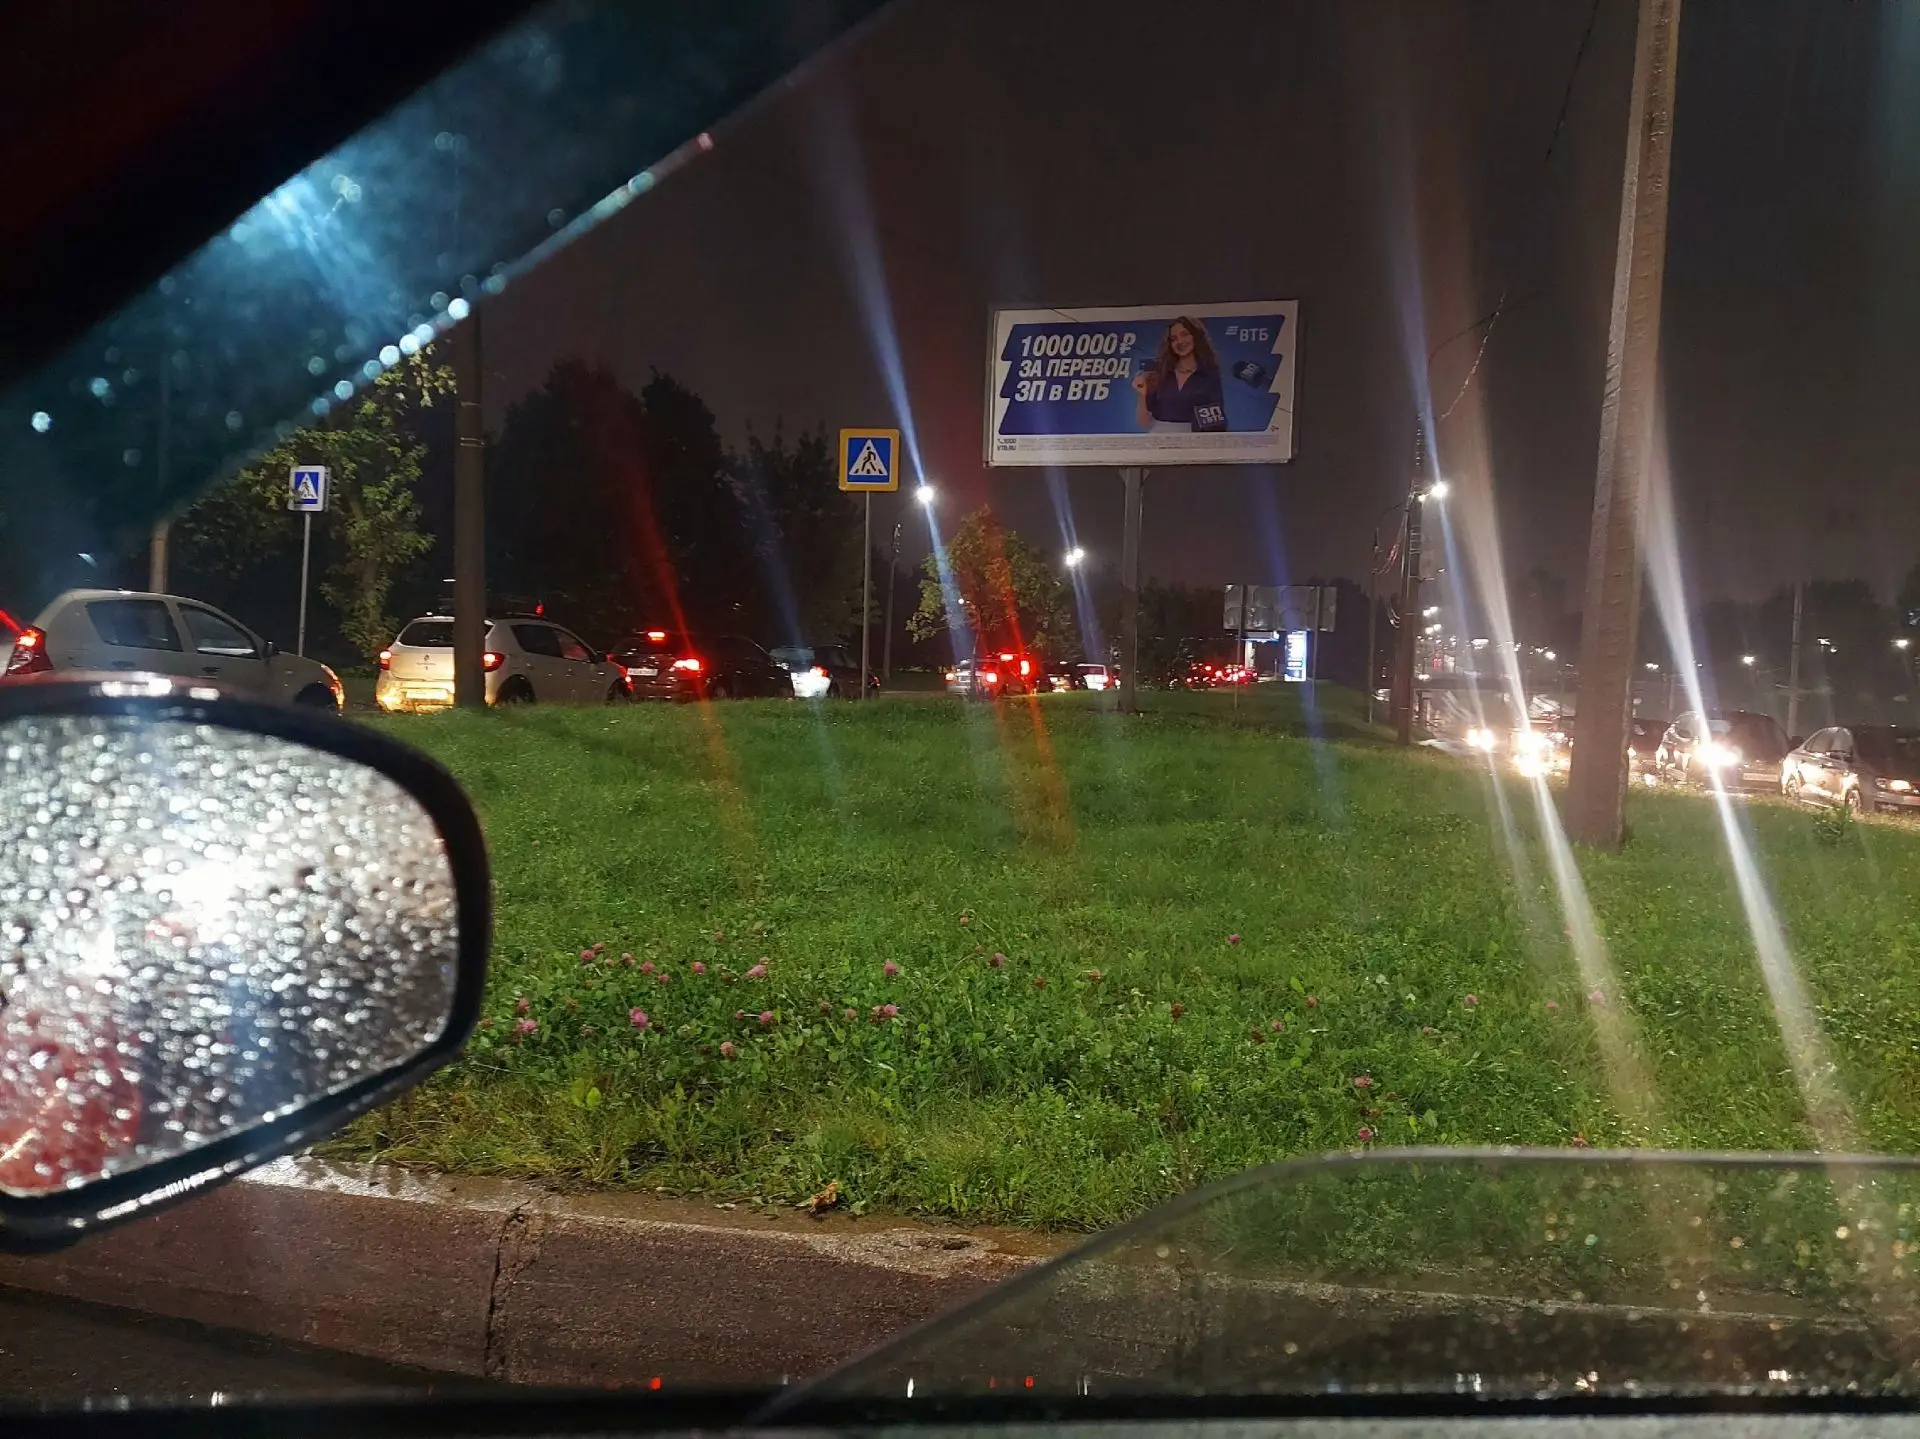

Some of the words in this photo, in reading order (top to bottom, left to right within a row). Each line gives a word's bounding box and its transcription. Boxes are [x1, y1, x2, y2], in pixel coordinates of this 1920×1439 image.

[1239, 327, 1270, 343] ВТБ
[1018, 359, 1042, 378] ЗА
[1046, 357, 1132, 378] ПЕРЕВОД
[1014, 380, 1047, 402] ЗП
[1049, 384, 1063, 401] в
[1067, 379, 1111, 401] ВТБ
[1198, 406, 1222, 417] ЗП
